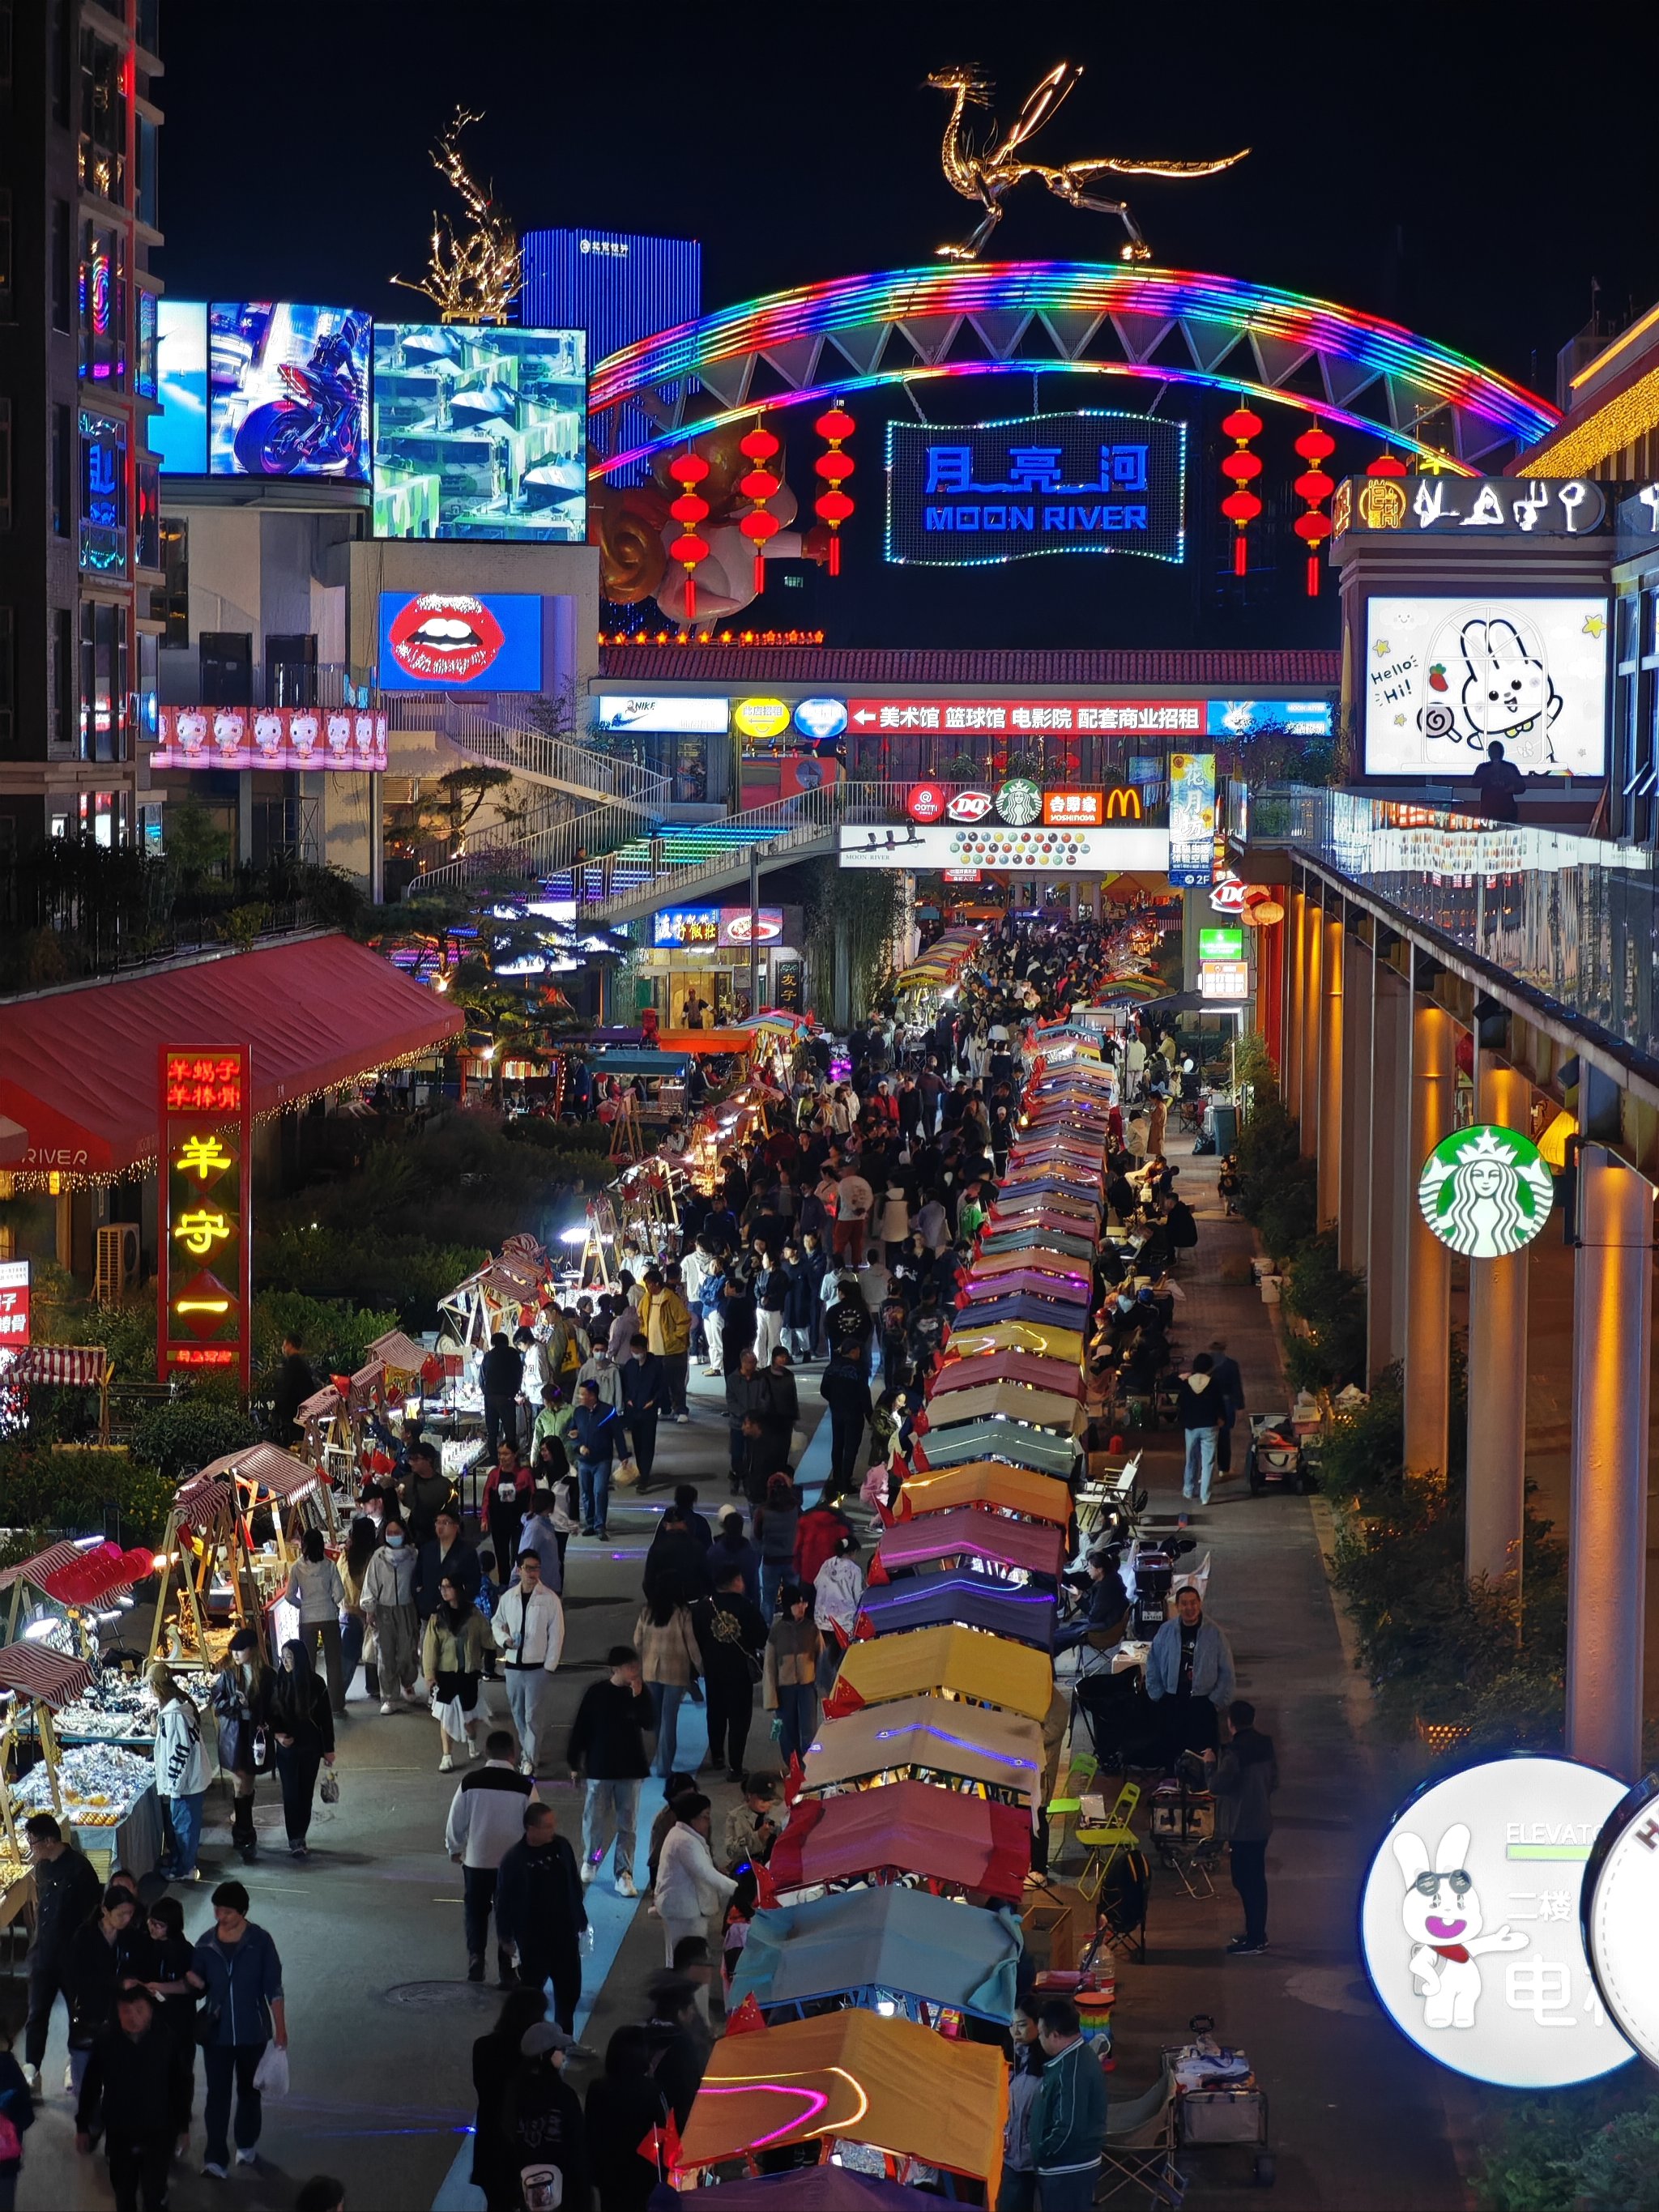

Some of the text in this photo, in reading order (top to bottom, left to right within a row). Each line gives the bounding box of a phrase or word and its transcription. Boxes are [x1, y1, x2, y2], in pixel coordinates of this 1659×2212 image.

[926, 445, 1148, 493] 月亮河
[927, 506, 1146, 530] MOON RIVER
[1371, 661, 1411, 684] Hello
[1384, 679, 1412, 704] Hi!
[635, 702, 655, 710] NIKE
[744, 706, 783, 716] 此店招租
[880, 707, 1200, 729] 美术馆 篮球馆 电影院 配套商业招租
[957, 798, 984, 813] DQ
[1050, 796, 1097, 812] 吉野家
[1182, 763, 1205, 837] 花月坊
[1196, 876, 1210, 884] 2F
[22, 1149, 87, 1165] RIVER
[1506, 1889, 1572, 1922] 二楼
